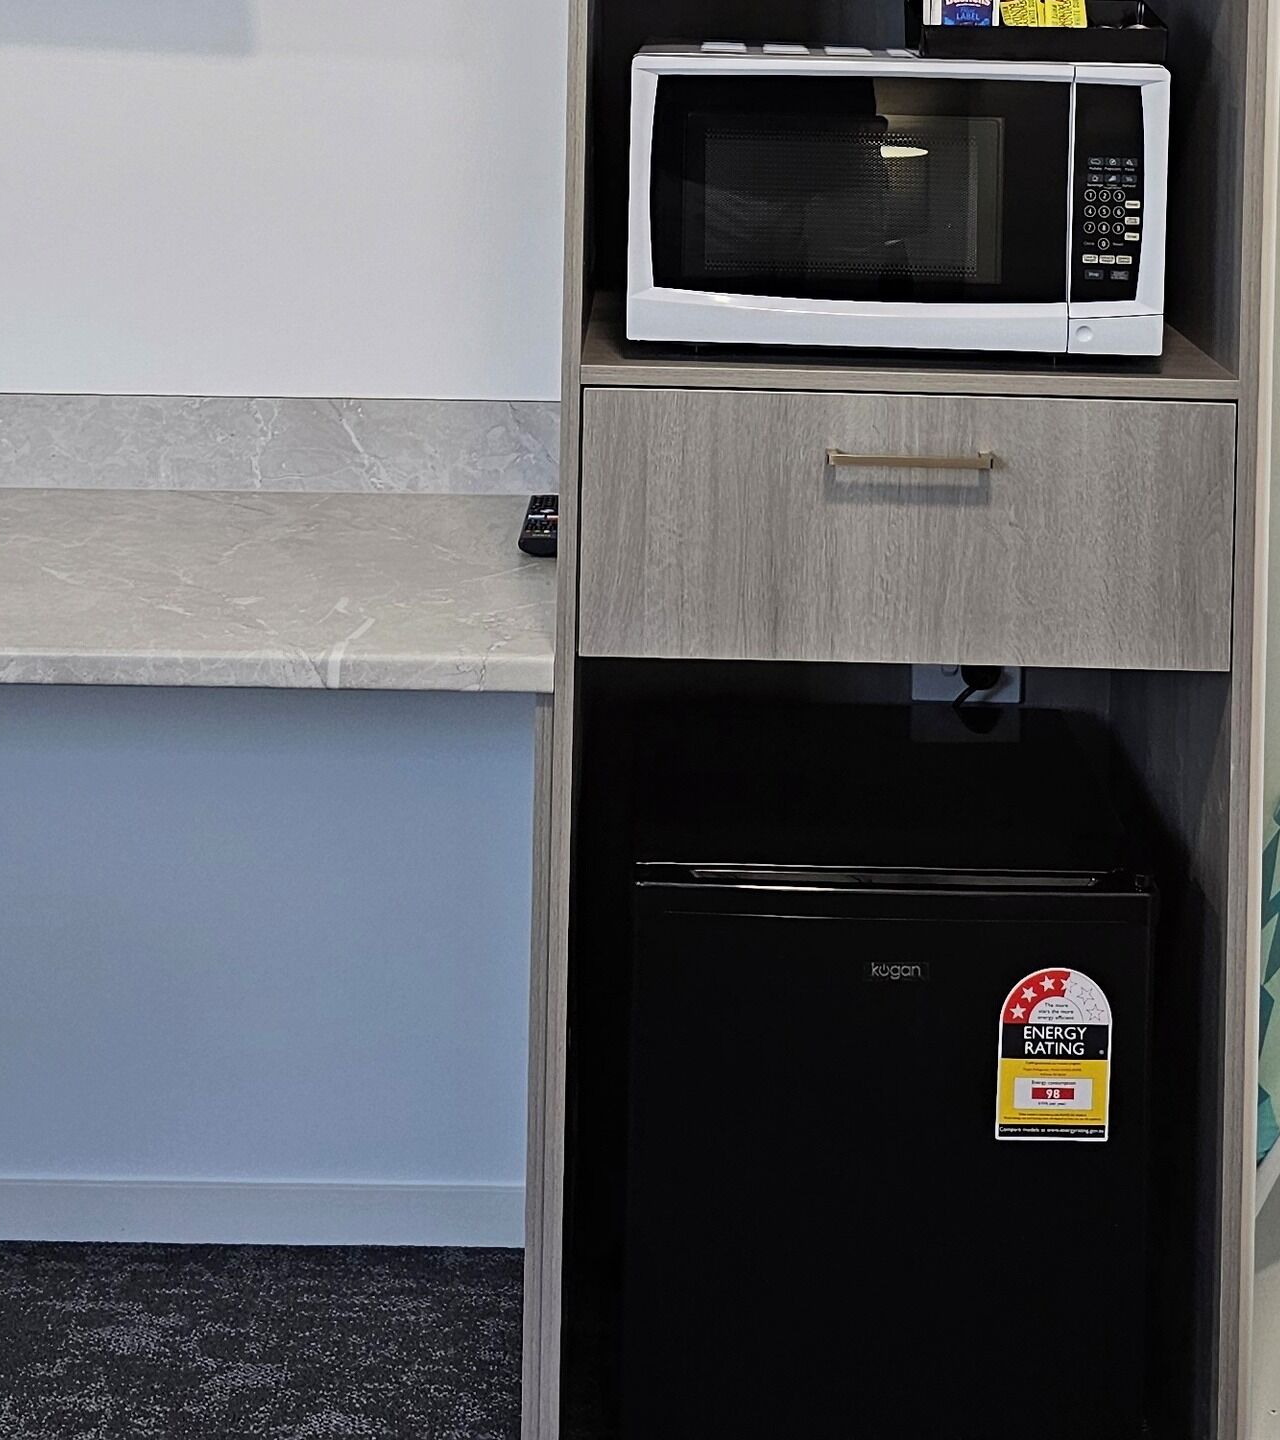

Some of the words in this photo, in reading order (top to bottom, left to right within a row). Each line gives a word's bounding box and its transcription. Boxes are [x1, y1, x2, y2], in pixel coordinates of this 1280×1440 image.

[871, 962, 921, 980] kogan
[1023, 1025, 1087, 1040] ENERGY
[1024, 1041, 1085, 1056] RATING
[1045, 1089, 1061, 1099] 98
